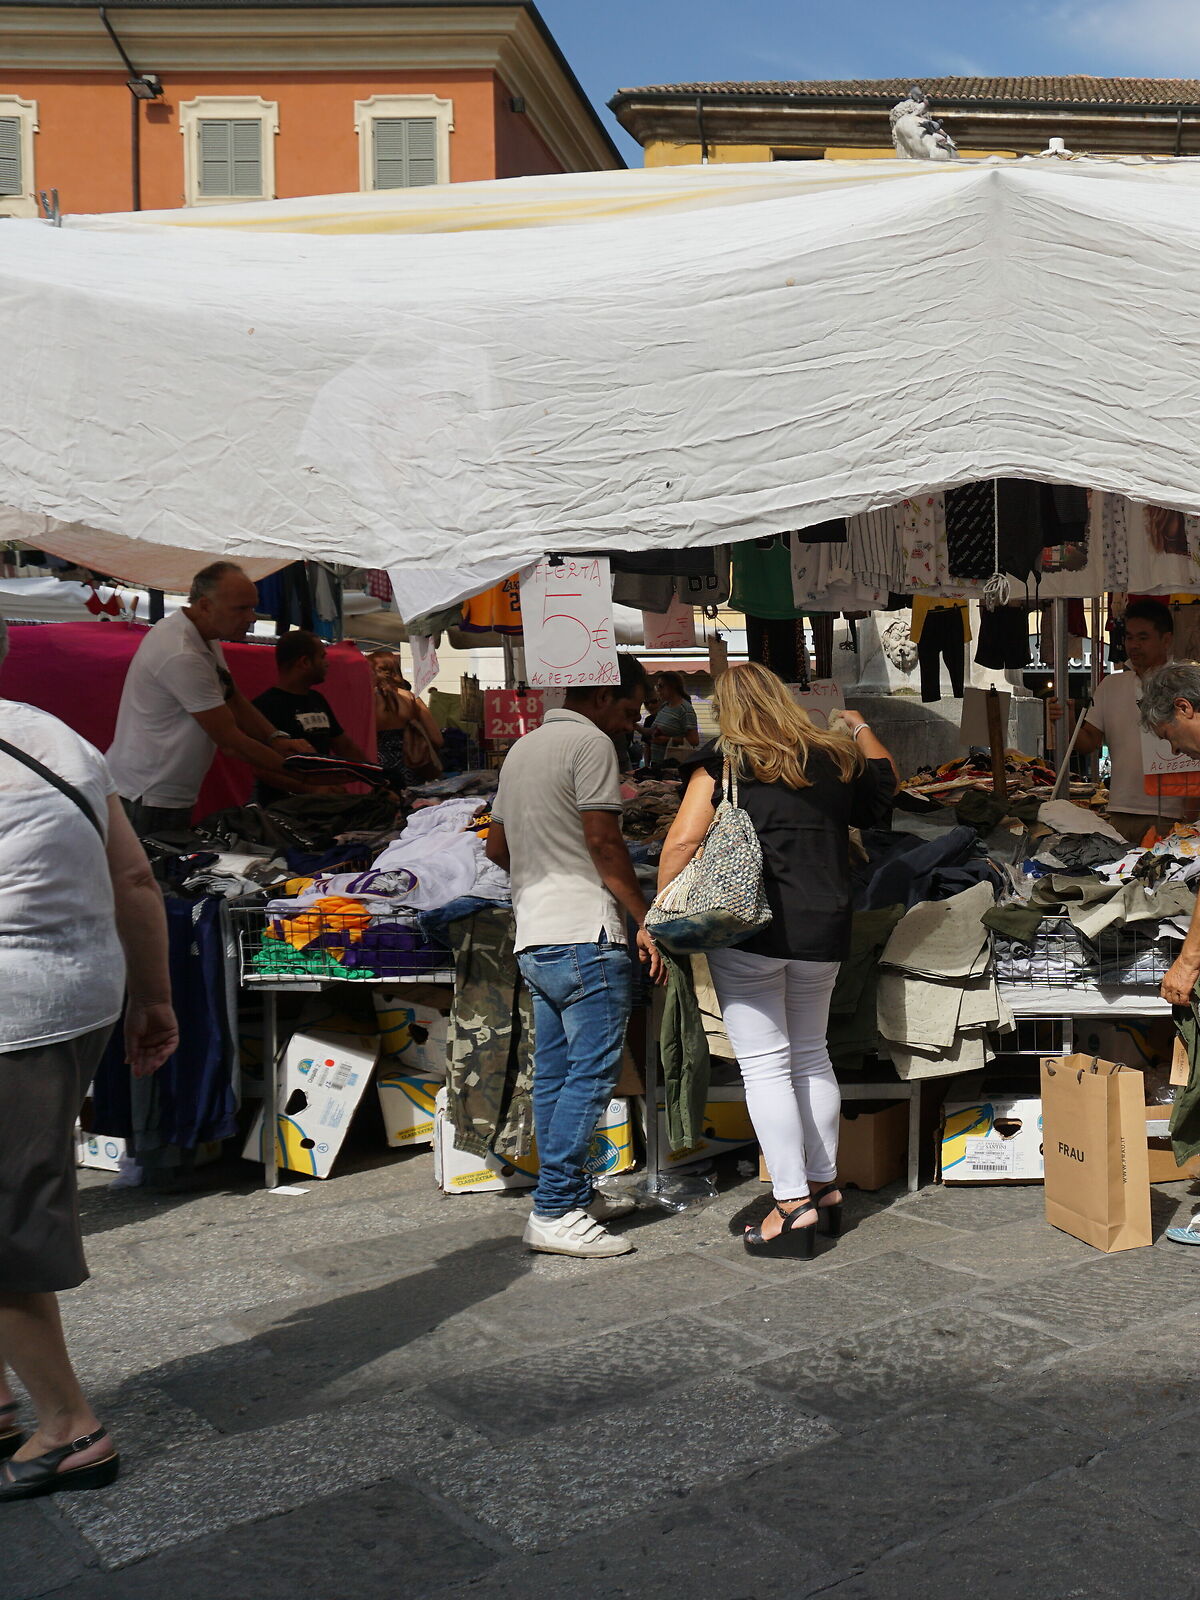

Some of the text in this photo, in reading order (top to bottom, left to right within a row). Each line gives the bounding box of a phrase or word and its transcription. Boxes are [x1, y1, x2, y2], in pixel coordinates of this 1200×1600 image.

[537, 587, 592, 669] 5
[586, 1147, 618, 1173] Chiquita
[1058, 1141, 1084, 1162] FRAU
